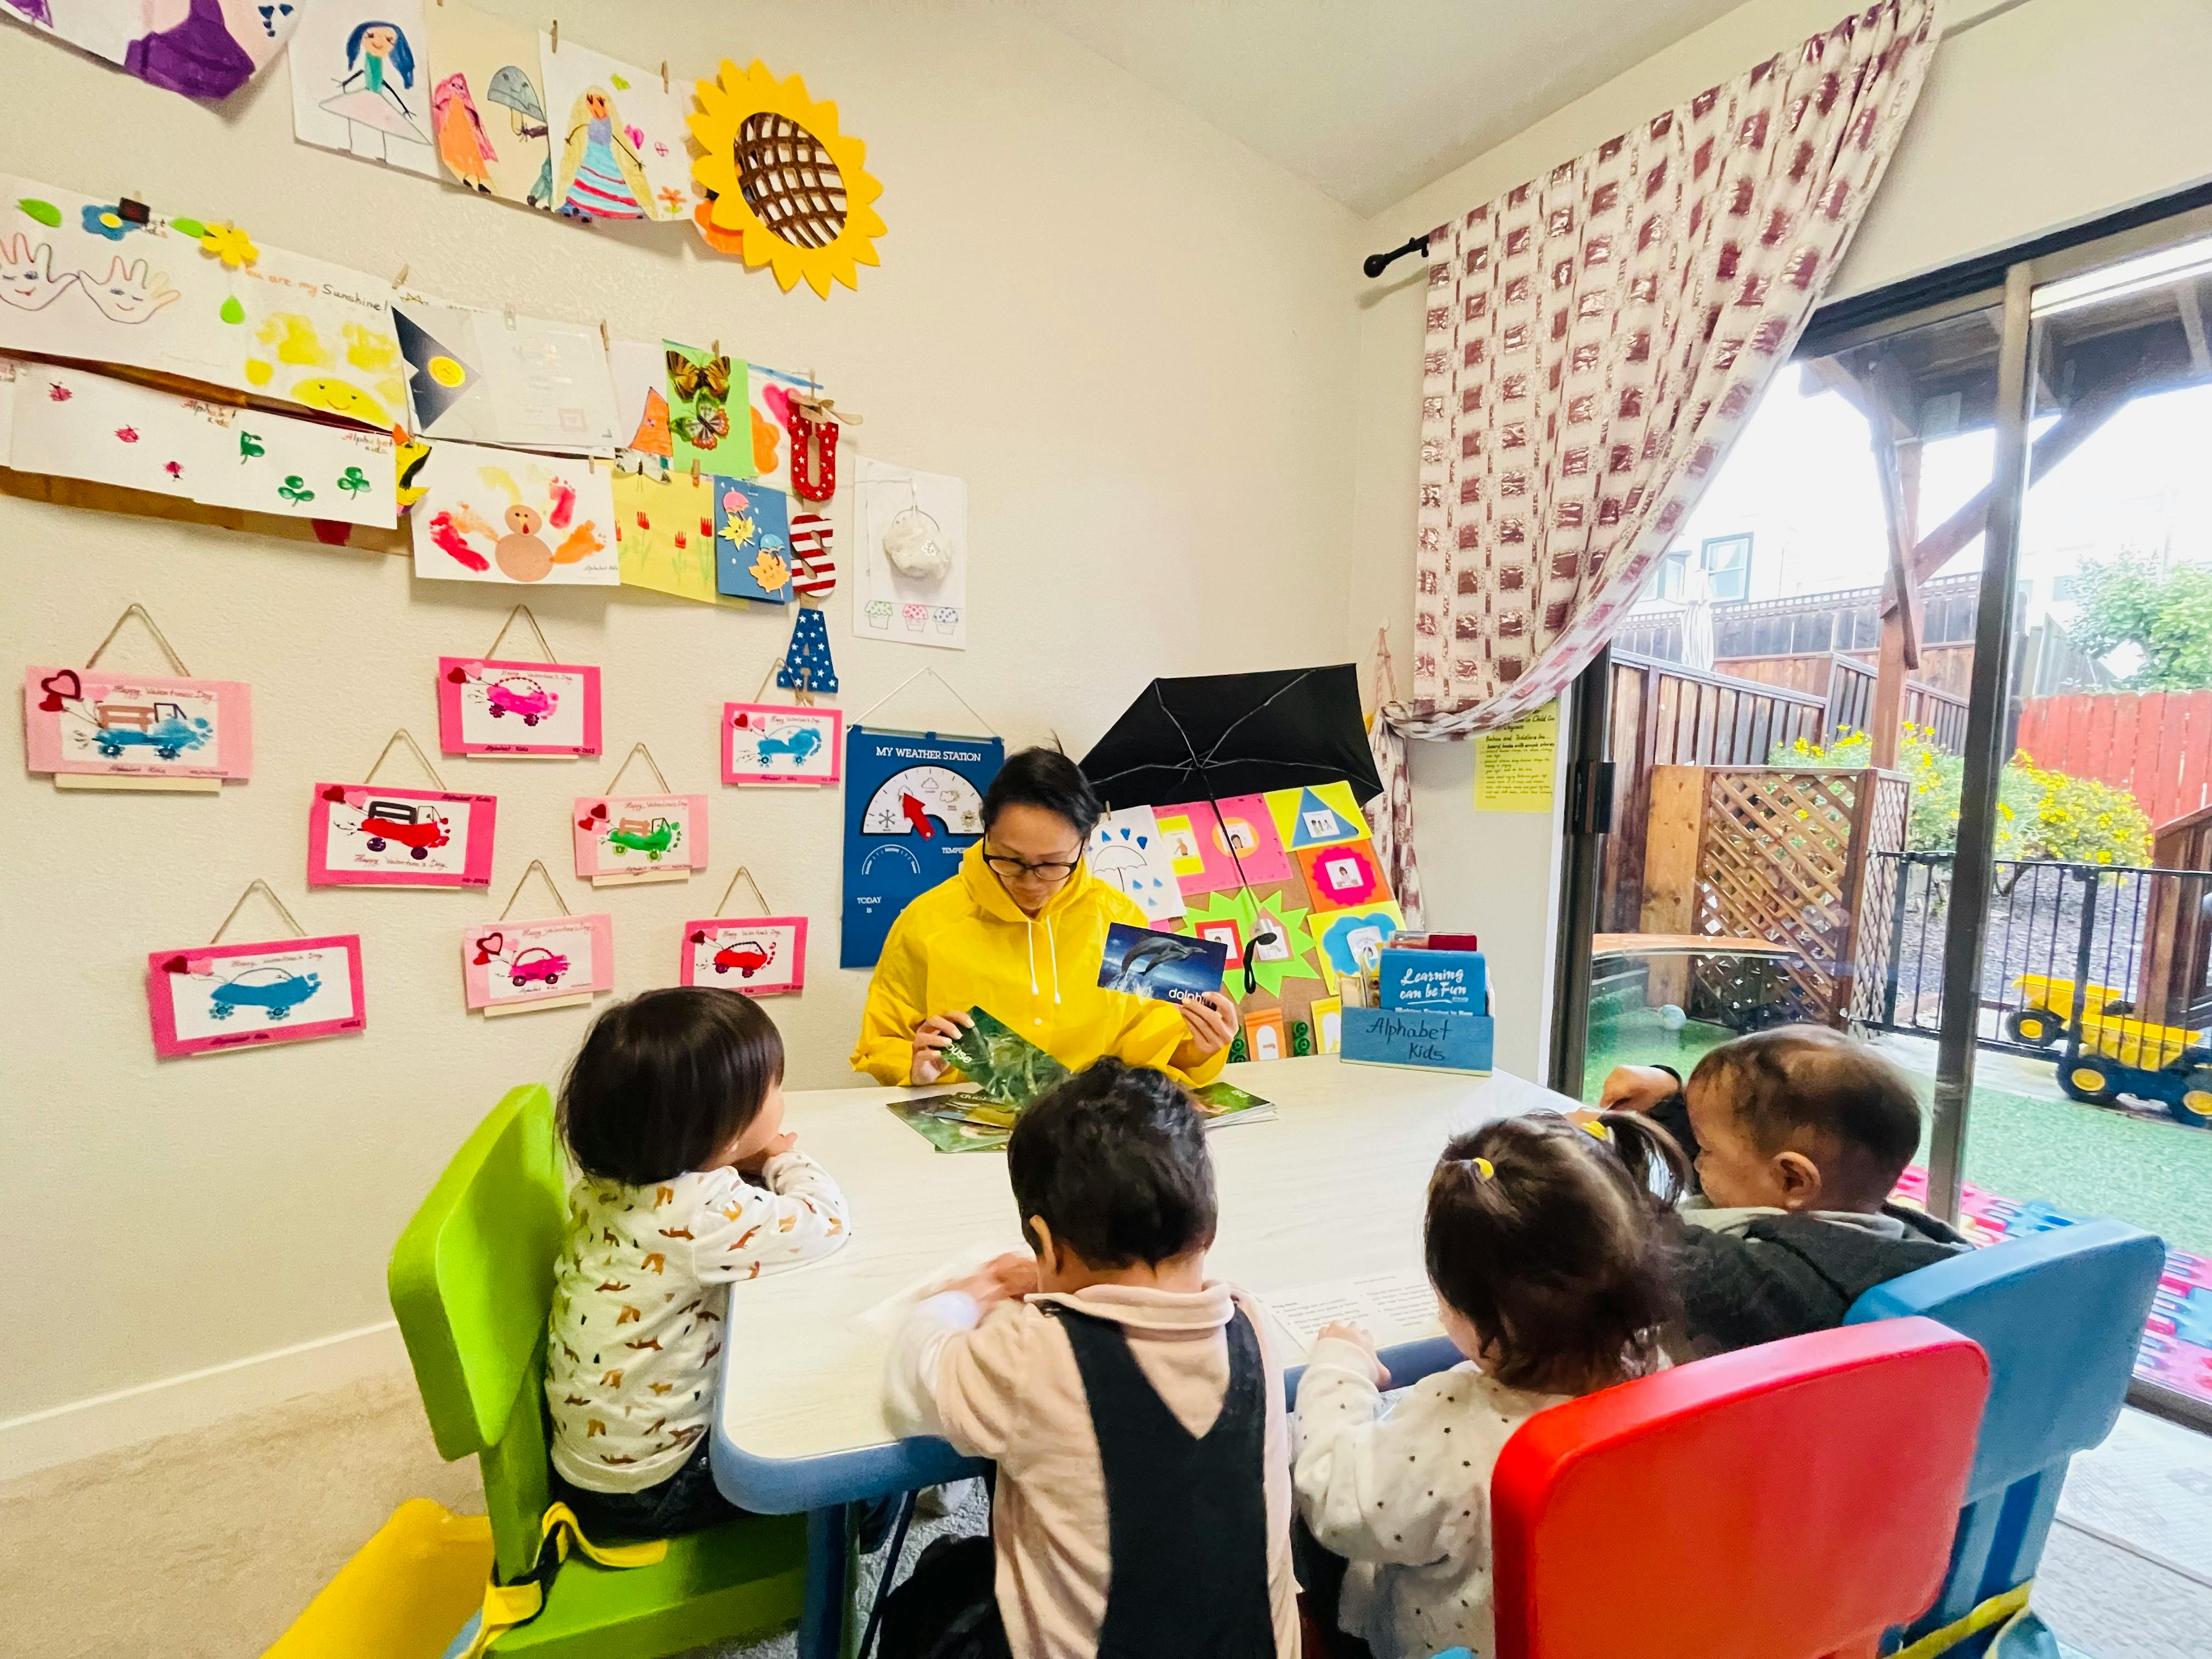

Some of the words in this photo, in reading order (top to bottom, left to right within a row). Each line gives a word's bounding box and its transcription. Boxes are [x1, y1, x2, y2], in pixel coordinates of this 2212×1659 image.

[269, 275, 292, 287] are
[299, 282, 318, 297] my
[321, 284, 388, 314] Sunshine!
[876, 746, 893, 757] MY
[895, 747, 941, 760] WEATHER
[943, 751, 981, 762] STATION
[857, 896, 882, 905] TODAY
[1400, 968, 1464, 986] Learning
[1399, 989, 1423, 1000] can
[1425, 983, 1438, 998] be
[1440, 981, 1467, 997] Fun
[1365, 1017, 1452, 1045] Alphabet
[946, 1043, 973, 1064] ouse
[1408, 1042, 1446, 1062] Kids
